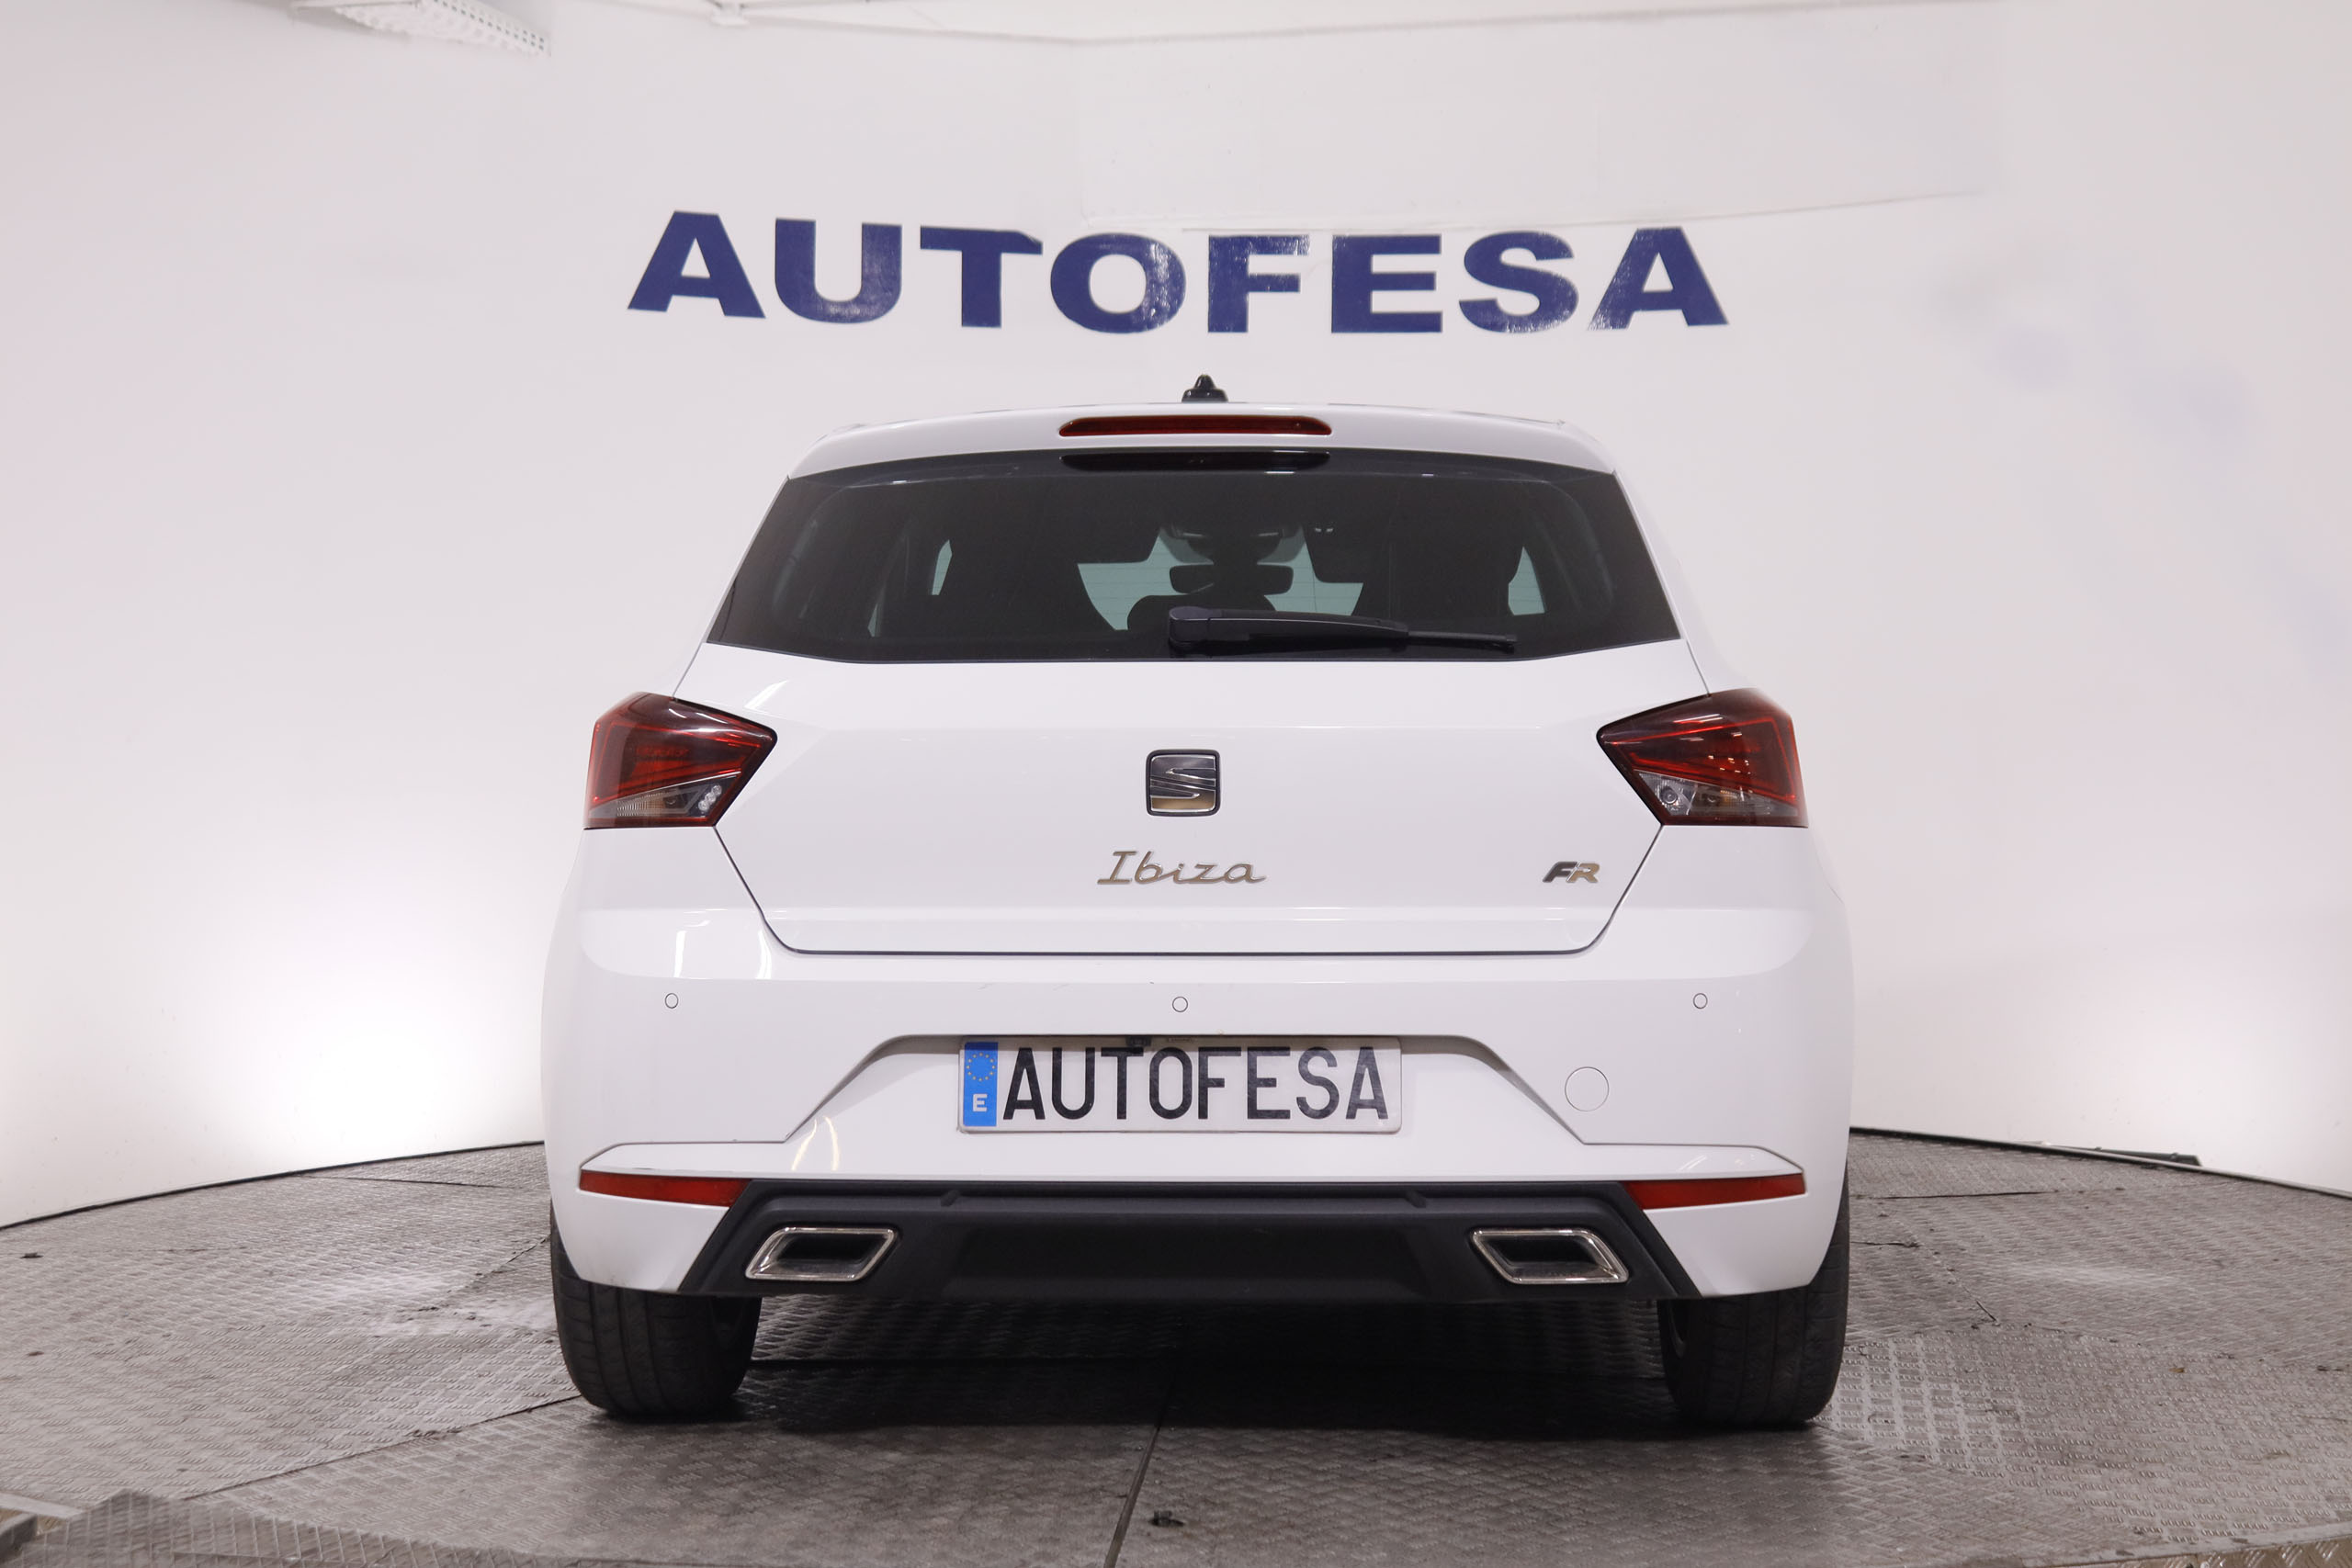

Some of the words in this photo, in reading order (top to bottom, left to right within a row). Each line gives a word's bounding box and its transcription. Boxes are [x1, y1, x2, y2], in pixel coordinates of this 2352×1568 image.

[627, 210, 1729, 334] AUTOFESA
[1097, 851, 1267, 885] Ibiza
[1543, 861, 1600, 884] FR
[1002, 1046, 1389, 1120] AUTOFESA
[972, 1093, 988, 1112] E
